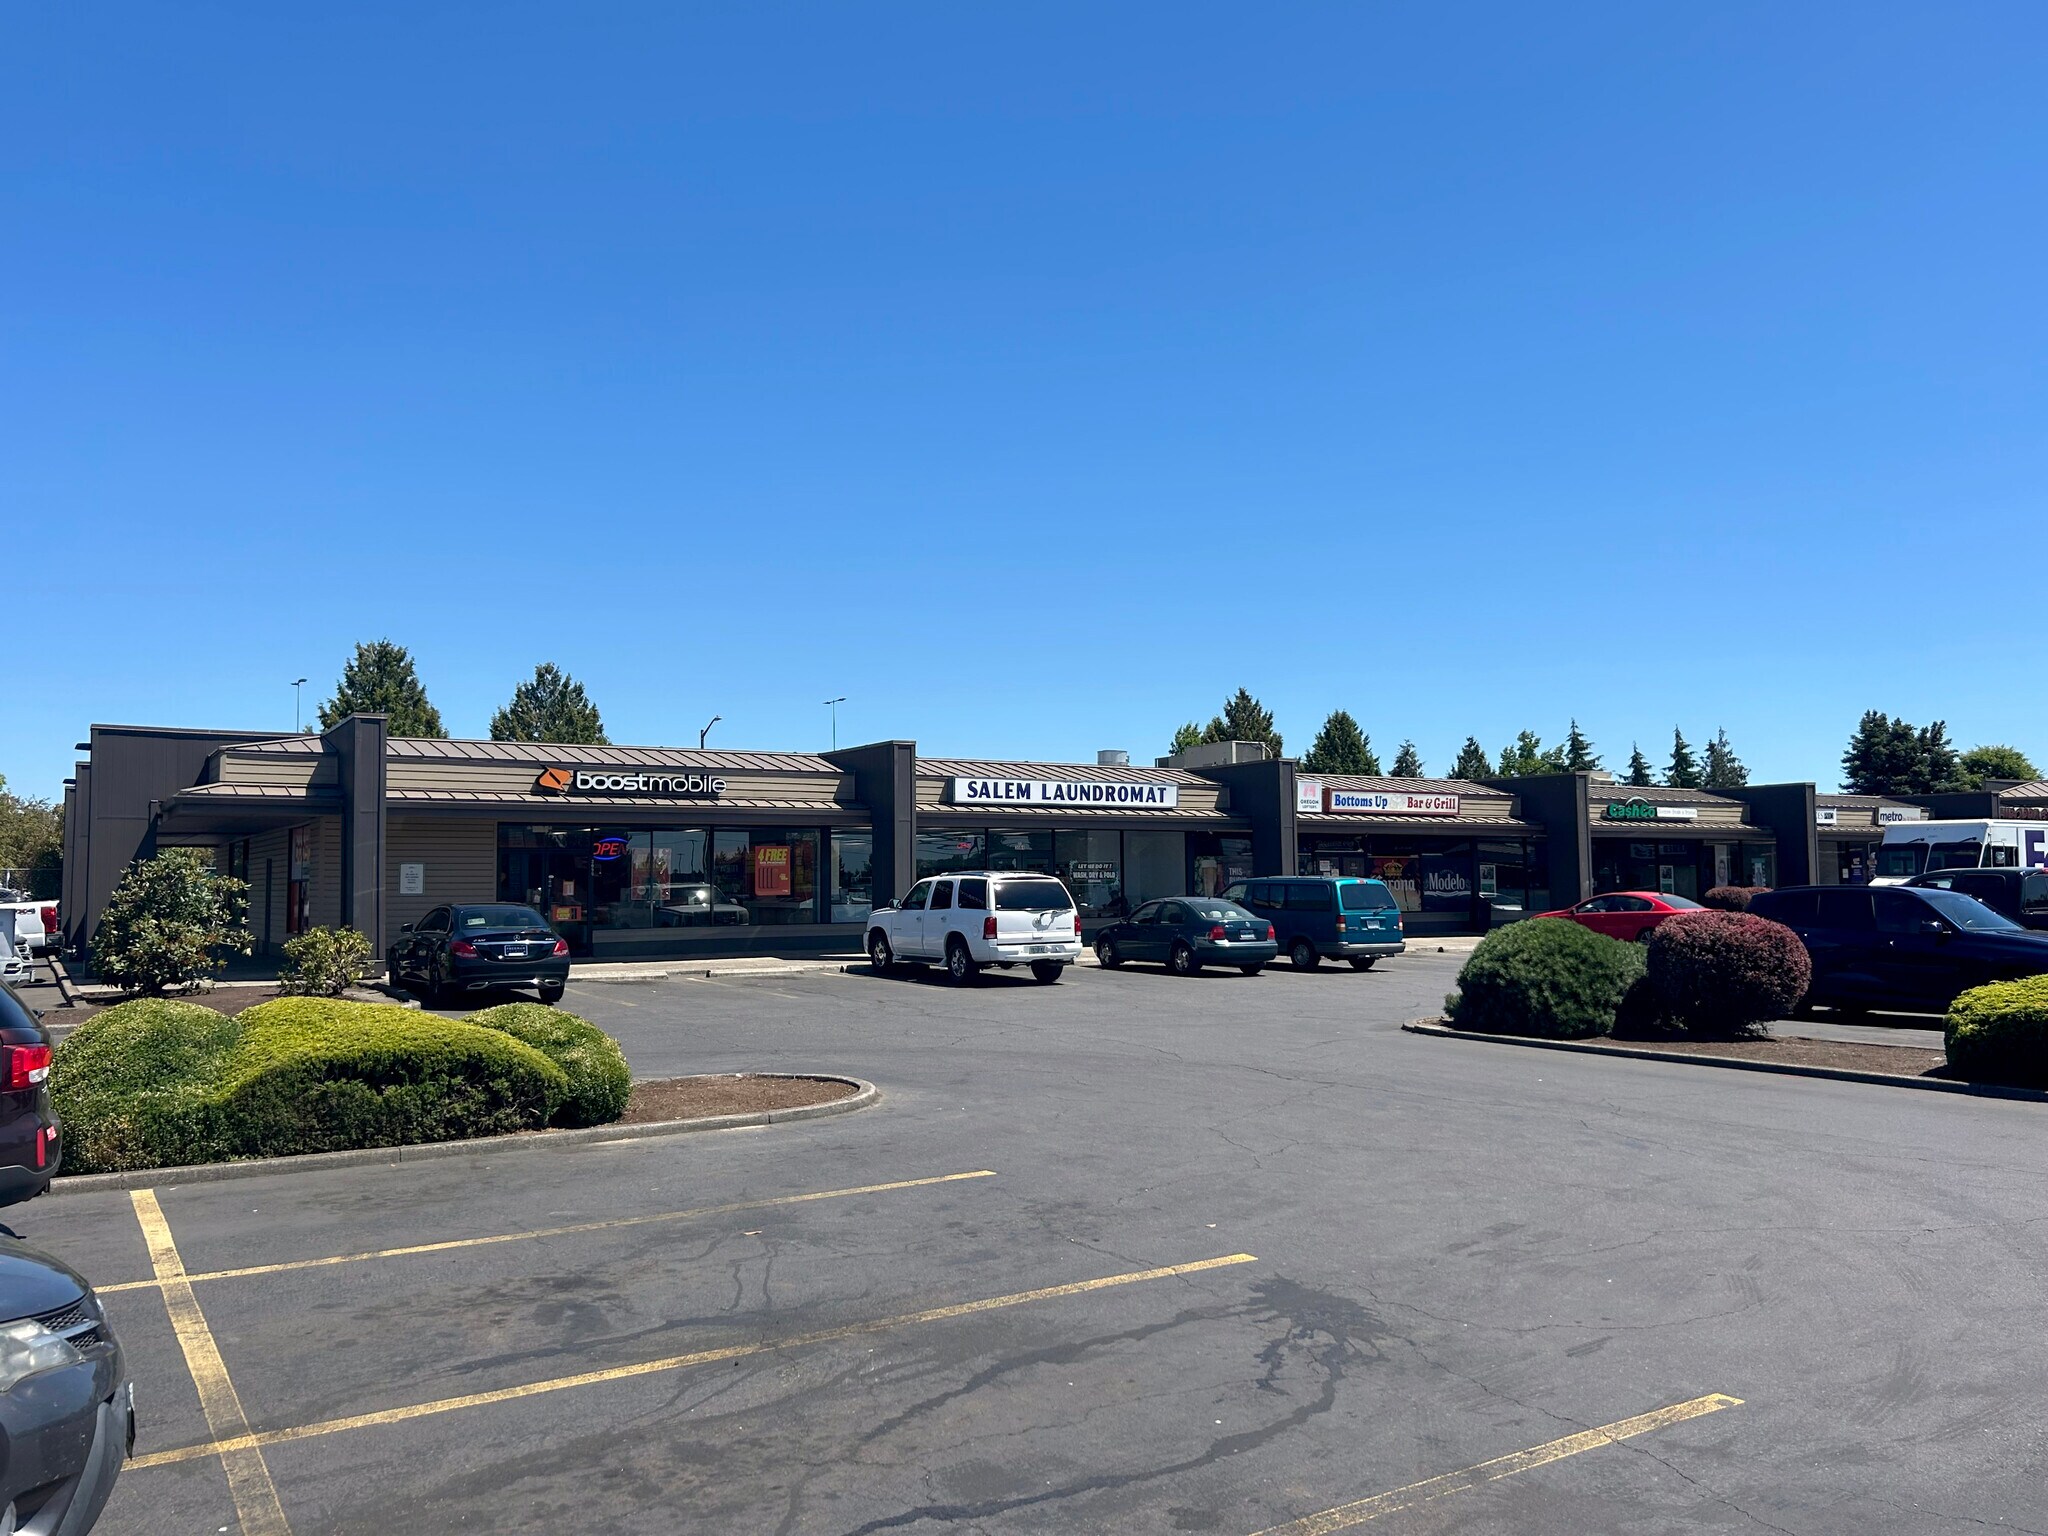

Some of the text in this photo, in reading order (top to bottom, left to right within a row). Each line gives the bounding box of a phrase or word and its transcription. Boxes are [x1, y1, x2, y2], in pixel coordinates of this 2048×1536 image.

[576, 771, 727, 793] boostmobile
[967, 780, 1167, 803] SALEM LAUNDROMAT
[1334, 794, 1456, 810] Bottoms Up Bar & Grill
[1609, 803, 1656, 818] CashCo
[1880, 811, 1903, 822] metro
[758, 848, 788, 862] 4 FREE
[1228, 867, 1243, 876] THIS
[1428, 872, 1466, 891] Modelo
